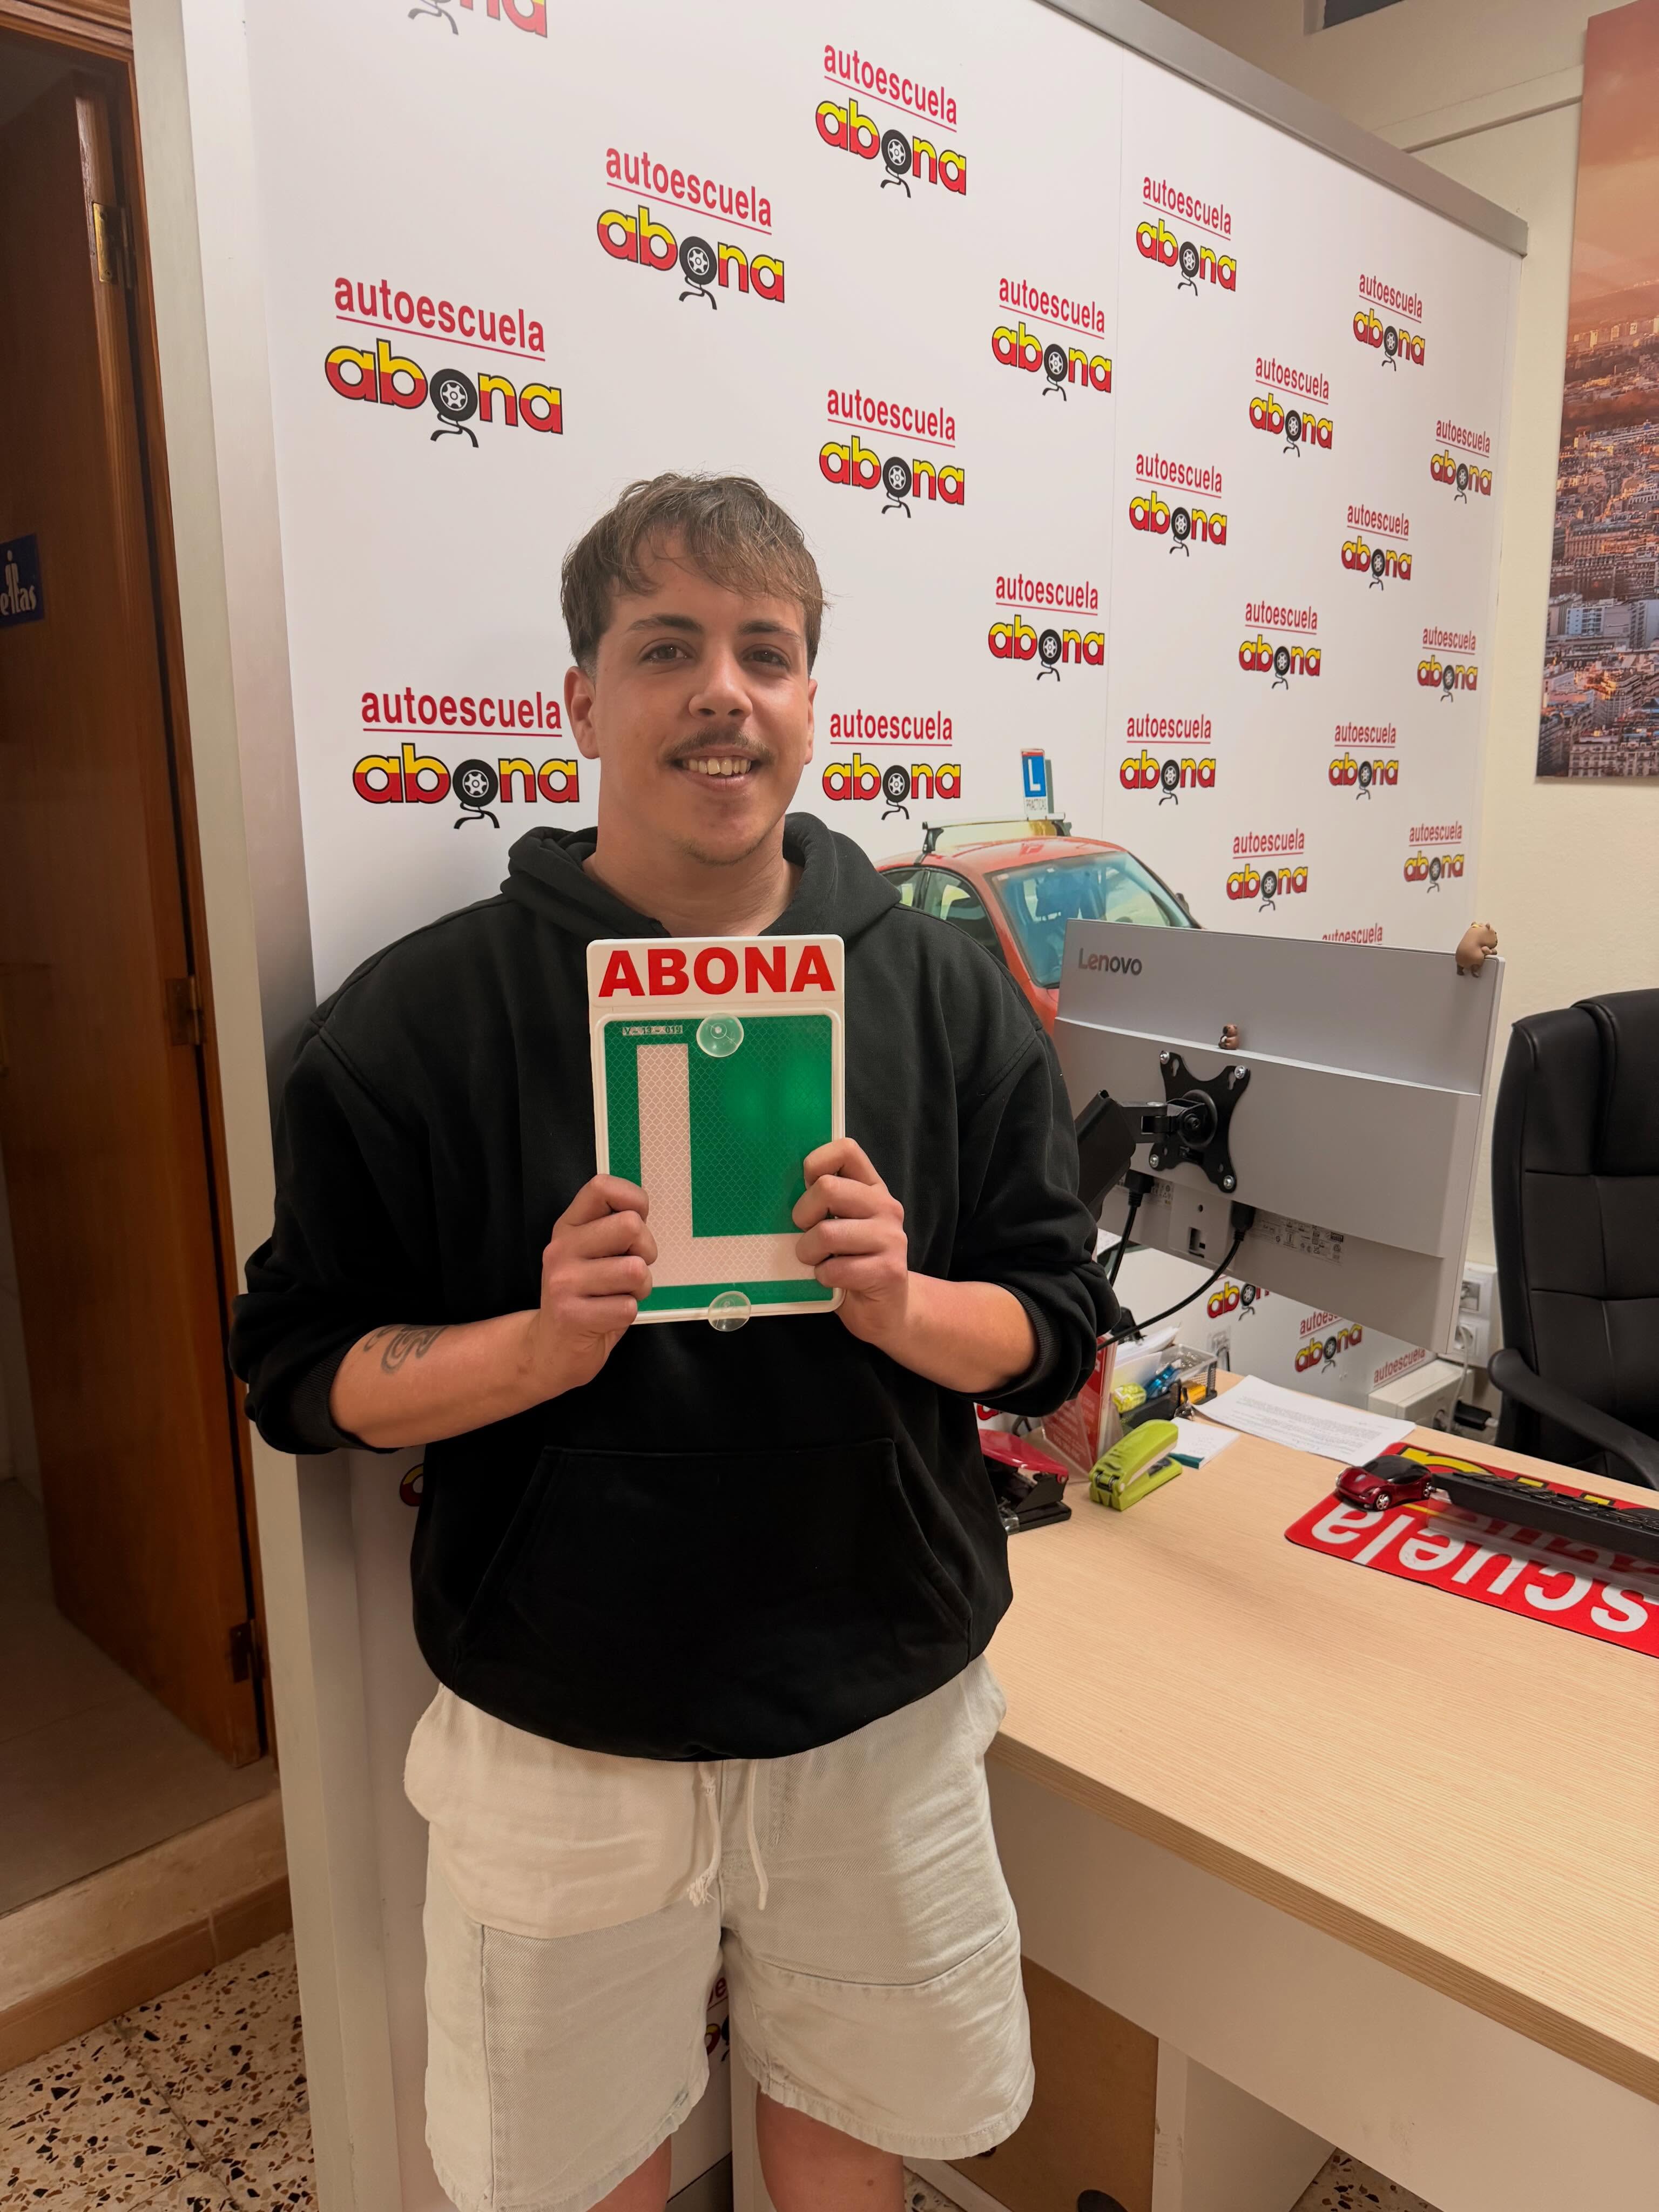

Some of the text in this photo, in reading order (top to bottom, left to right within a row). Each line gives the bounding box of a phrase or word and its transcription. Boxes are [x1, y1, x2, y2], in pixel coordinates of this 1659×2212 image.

[824, 44, 957, 125] autoescuela
[815, 98, 966, 196] abona
[606, 147, 772, 227] autoescuela
[1143, 176, 1231, 235] autoescuela
[597, 205, 785, 303] abona
[1136, 218, 1236, 292] abona
[334, 276, 544, 353] autoescuela
[999, 278, 1105, 333] autoescuela
[1359, 273, 1422, 319] autoescuela
[992, 321, 1112, 394] abona
[1353, 308, 1425, 366] abona
[325, 338, 563, 434] abona
[1256, 357, 1329, 400] autoescuela
[827, 389, 955, 441] autoescuela
[1249, 393, 1333, 449] abona
[1436, 420, 1491, 453] autoescuela
[819, 435, 965, 505] abona
[1136, 453, 1222, 493] autoescuela
[1431, 450, 1492, 496] abona
[1129, 490, 1227, 545] abona
[1347, 505, 1409, 536] autoescuela
[1341, 536, 1412, 580] abona
[995, 574, 1098, 610] autoescuela
[1245, 601, 1318, 630] autoescuela
[988, 615, 1104, 665] abona
[1238, 635, 1321, 676] abona
[1422, 626, 1476, 651] autoescuela
[1417, 656, 1478, 691] abona
[361, 687, 562, 729] autoescuela
[830, 709, 952, 740] autoescuela
[1127, 714, 1211, 739] autoescuela
[1334, 723, 1396, 745] autoescuela
[352, 743, 580, 807] abona
[822, 753, 961, 802] abona
[1028, 759, 1041, 791] L
[1119, 750, 1216, 791] abona
[1328, 753, 1399, 787] abona
[1233, 829, 1304, 854] autoescuela
[1410, 821, 1462, 842] autoescuela
[1226, 864, 1308, 901] abona
[1404, 852, 1465, 881] abona
[598, 945, 836, 997] ABONA
[1078, 948, 1143, 975] Lenovo
[637, 1043, 817, 1287] L
[1207, 1281, 1269, 1319] abo
[1294, 1323, 1363, 1372] abona
[1374, 1348, 1425, 1384] autoescuela
